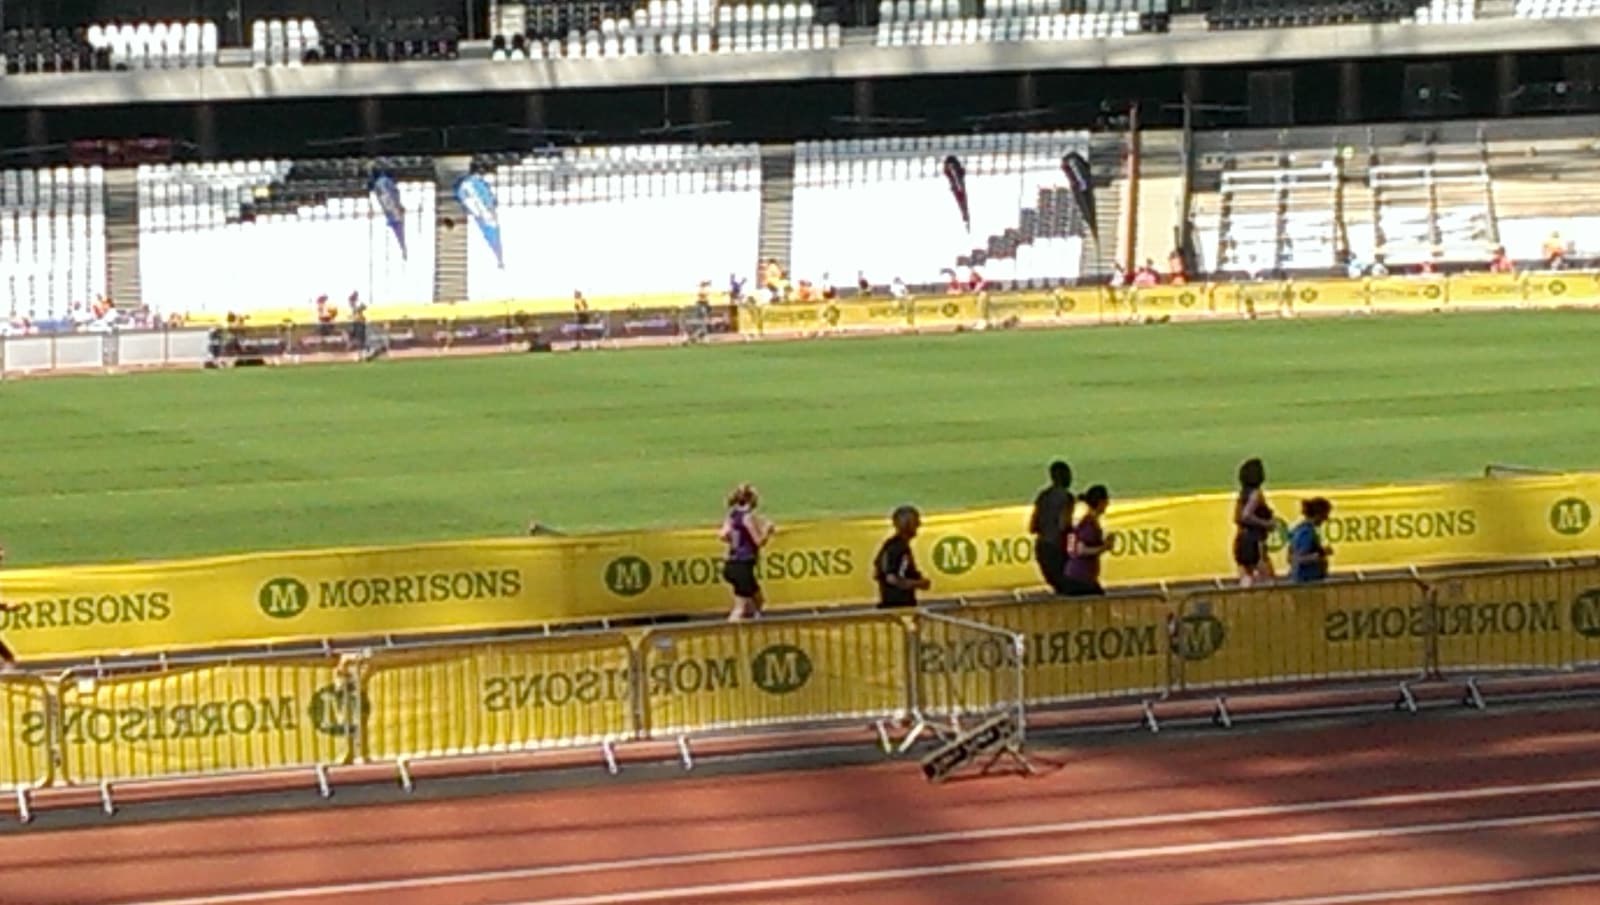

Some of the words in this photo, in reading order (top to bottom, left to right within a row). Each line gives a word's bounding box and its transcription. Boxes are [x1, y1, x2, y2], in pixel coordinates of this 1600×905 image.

[1325, 510, 1476, 543] ORRISONS
[986, 527, 1170, 566] MOONS
[660, 548, 853, 588] MOSONS
[318, 569, 522, 610] MORRISONS
[0, 592, 171, 631] RRISONS
